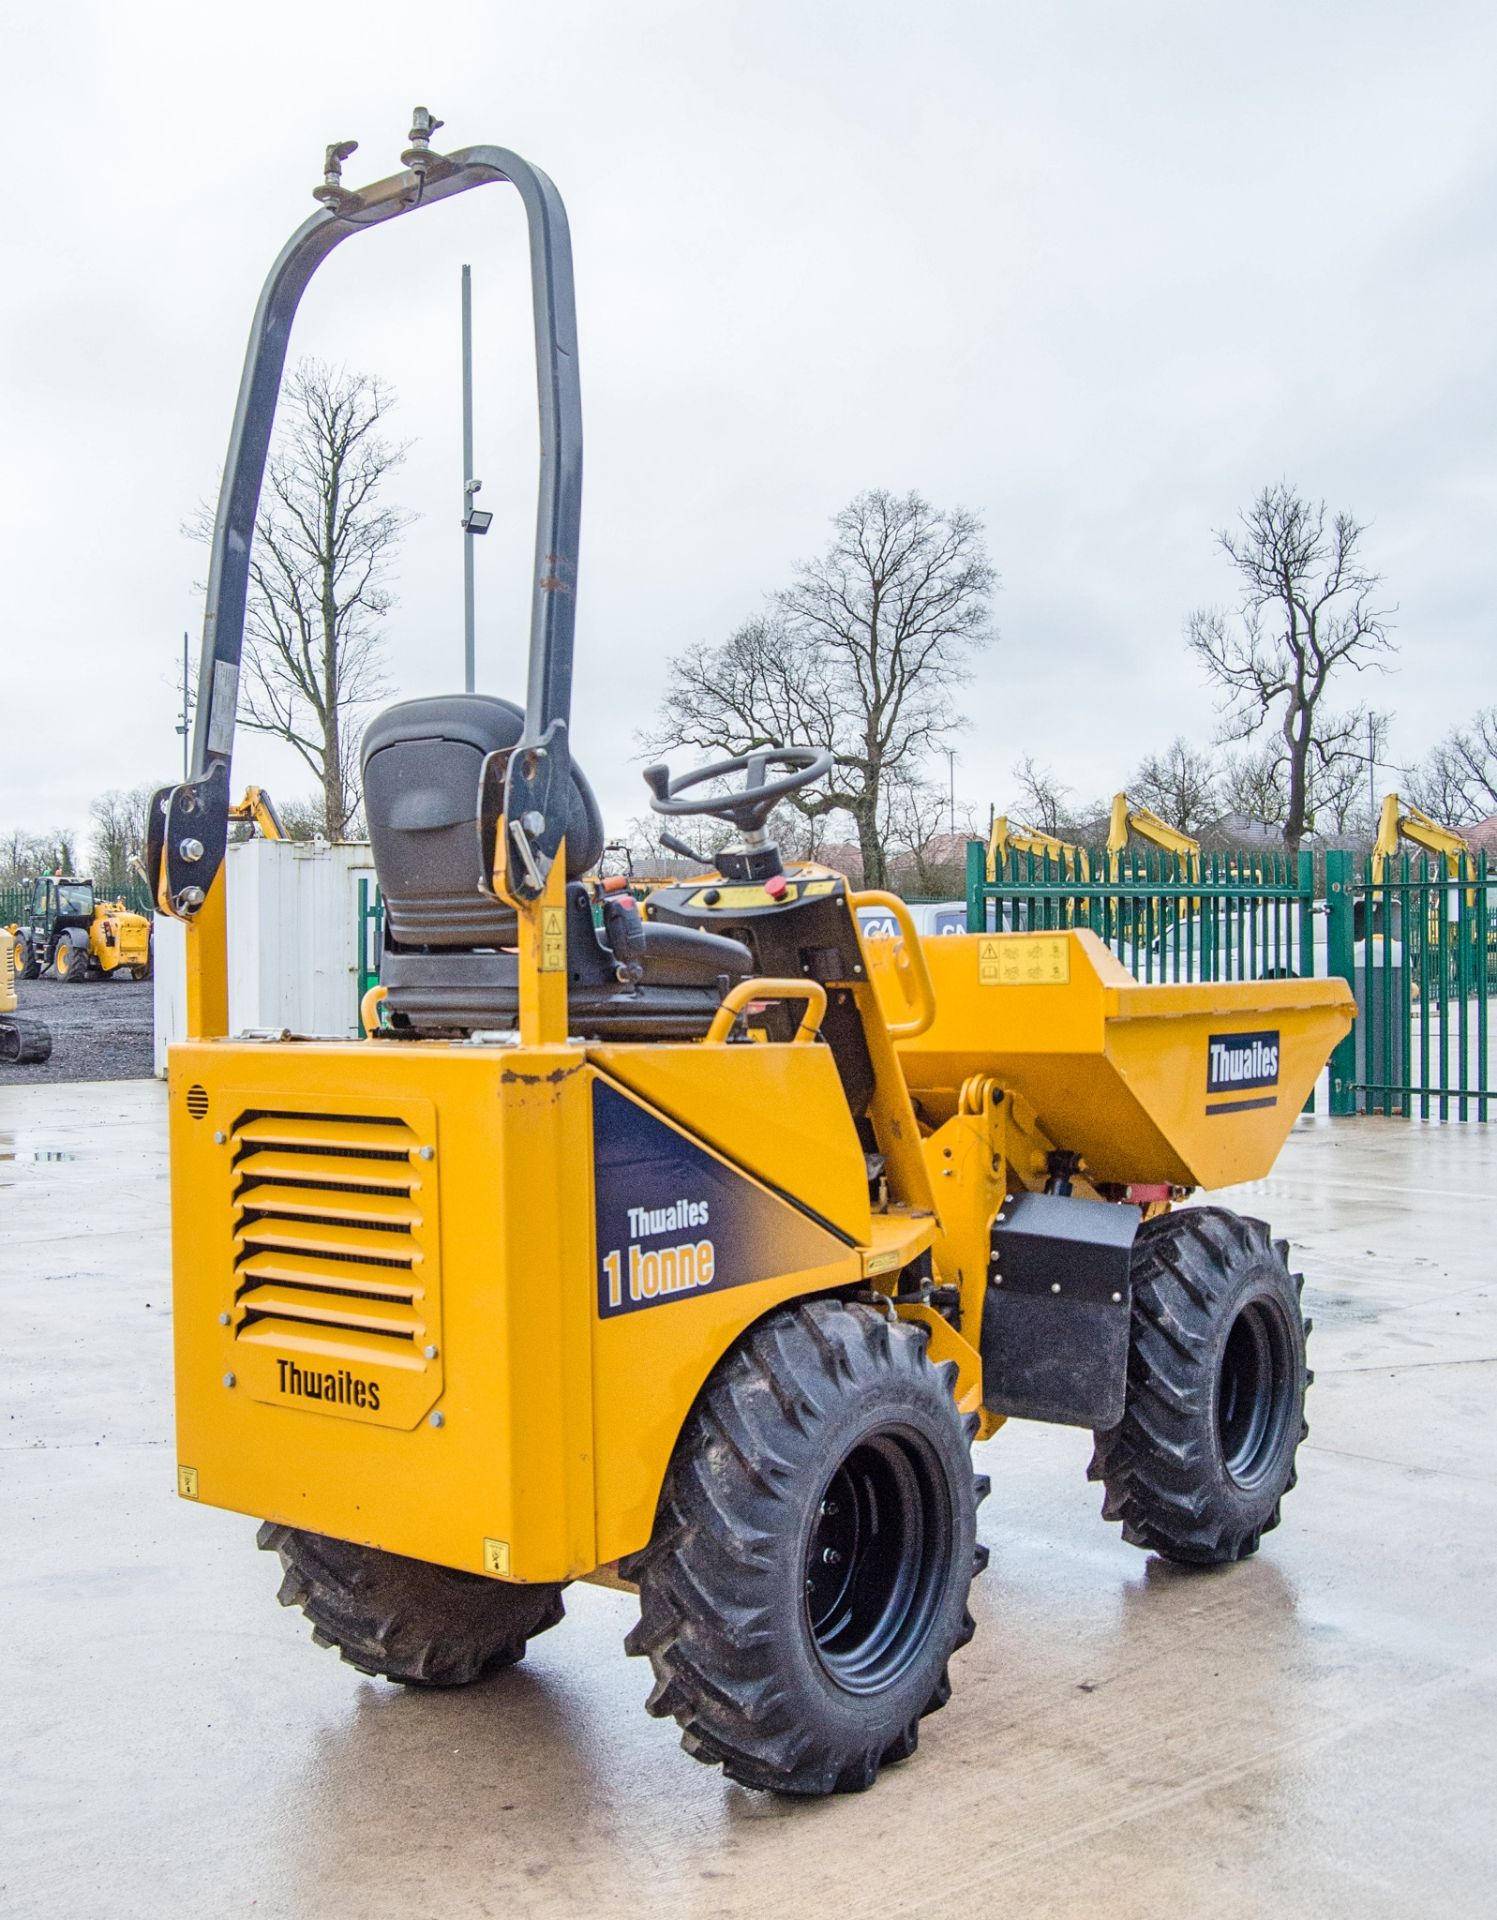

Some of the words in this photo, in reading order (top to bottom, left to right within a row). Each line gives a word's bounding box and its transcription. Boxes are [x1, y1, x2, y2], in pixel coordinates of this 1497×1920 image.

[1210, 1041, 1278, 1083] Thwaites
[627, 1199, 709, 1238] Thwaites
[603, 1250, 622, 1307] 1
[629, 1240, 715, 1301] tonne
[277, 1359, 380, 1411] Thwaites
